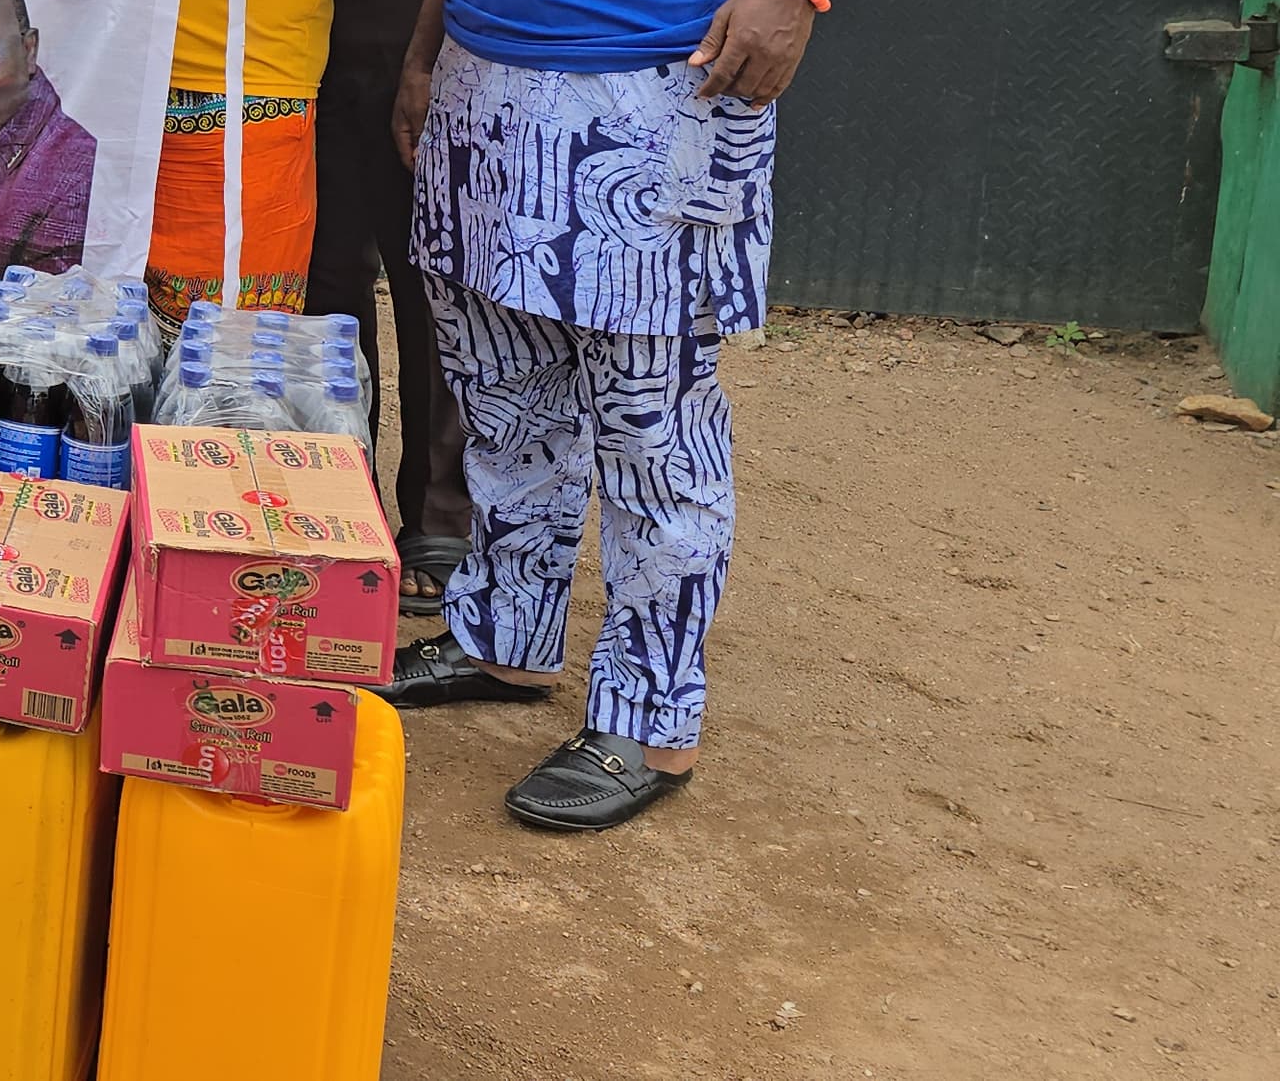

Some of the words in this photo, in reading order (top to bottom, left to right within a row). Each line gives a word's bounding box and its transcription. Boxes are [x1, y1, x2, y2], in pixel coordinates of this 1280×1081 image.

[292, 604, 317, 618] Roll
[334, 642, 362, 654] FOODS
[246, 727, 272, 743] Roll
[288, 767, 317, 779] FOODS
